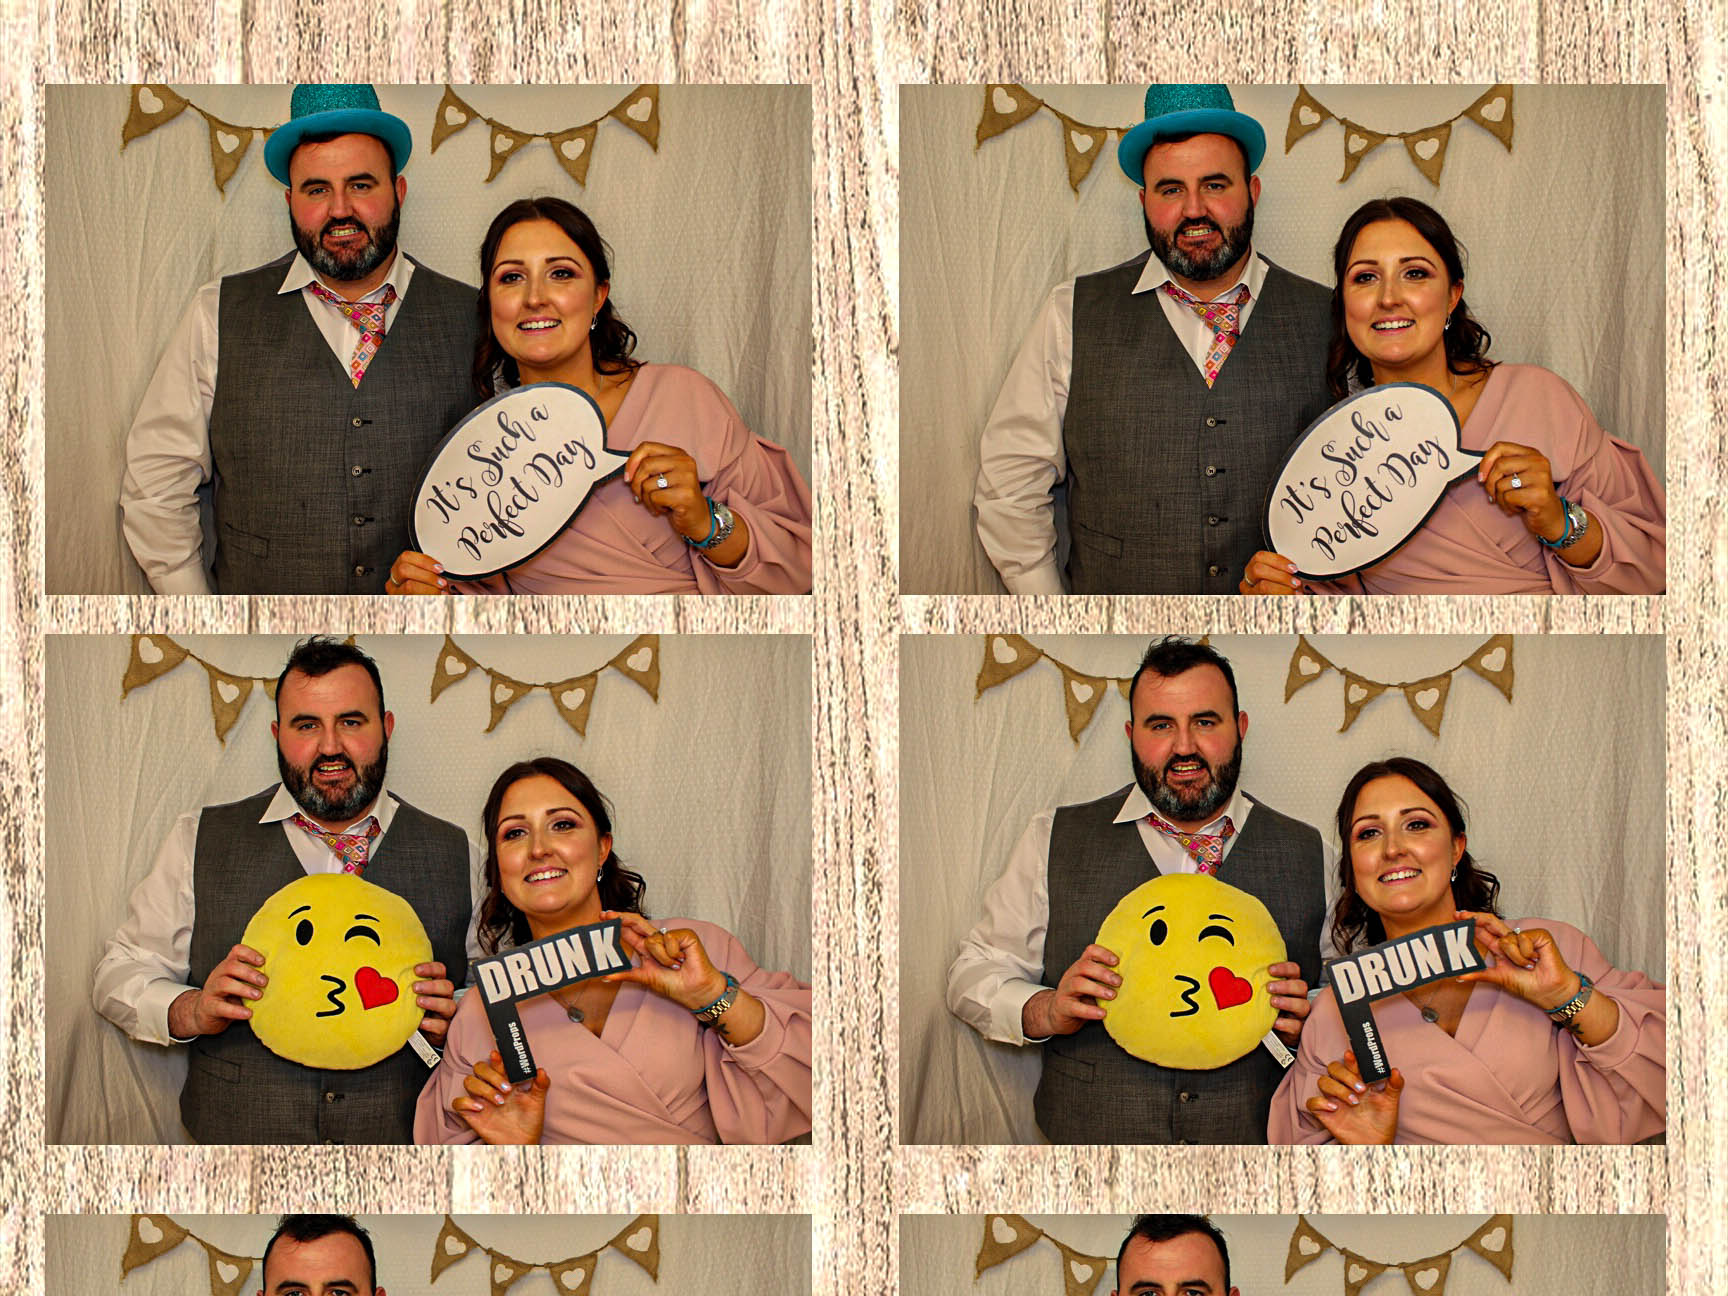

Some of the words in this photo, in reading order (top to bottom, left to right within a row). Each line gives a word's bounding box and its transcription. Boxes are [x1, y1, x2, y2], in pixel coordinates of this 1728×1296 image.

[427, 474, 478, 524] It's
[467, 410, 536, 486] Such
[530, 403, 550, 423] a
[457, 476, 541, 561] Perfect
[523, 435, 596, 488] Day
[1281, 474, 1332, 524] It's
[1321, 410, 1390, 486] Such
[1384, 403, 1404, 423] a
[1311, 476, 1395, 561] Perfect
[1377, 435, 1450, 488] Day
[477, 926, 623, 1004] DRUNK
[1331, 926, 1477, 1004] DRUNK
